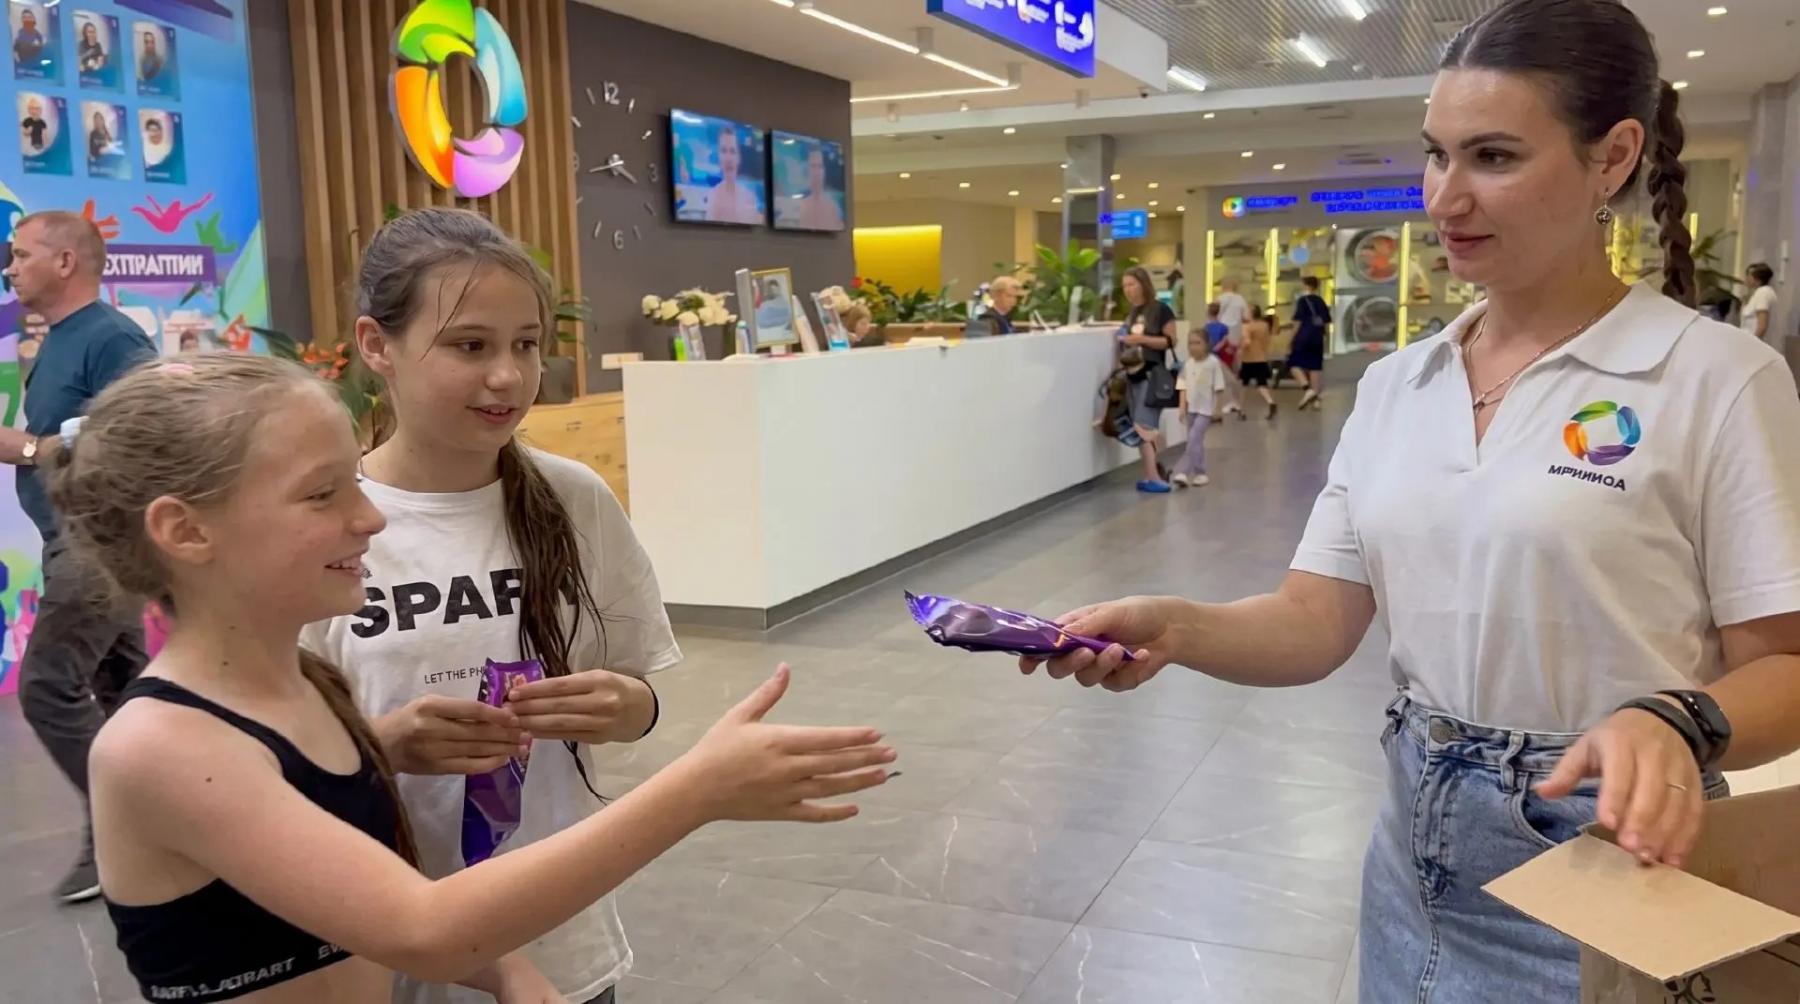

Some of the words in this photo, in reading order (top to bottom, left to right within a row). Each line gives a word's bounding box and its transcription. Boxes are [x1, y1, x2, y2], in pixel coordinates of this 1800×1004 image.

[604, 81, 621, 105] 12
[614, 230, 624, 249] 6
[424, 672, 444, 685] LET
[445, 668, 467, 681] THE
